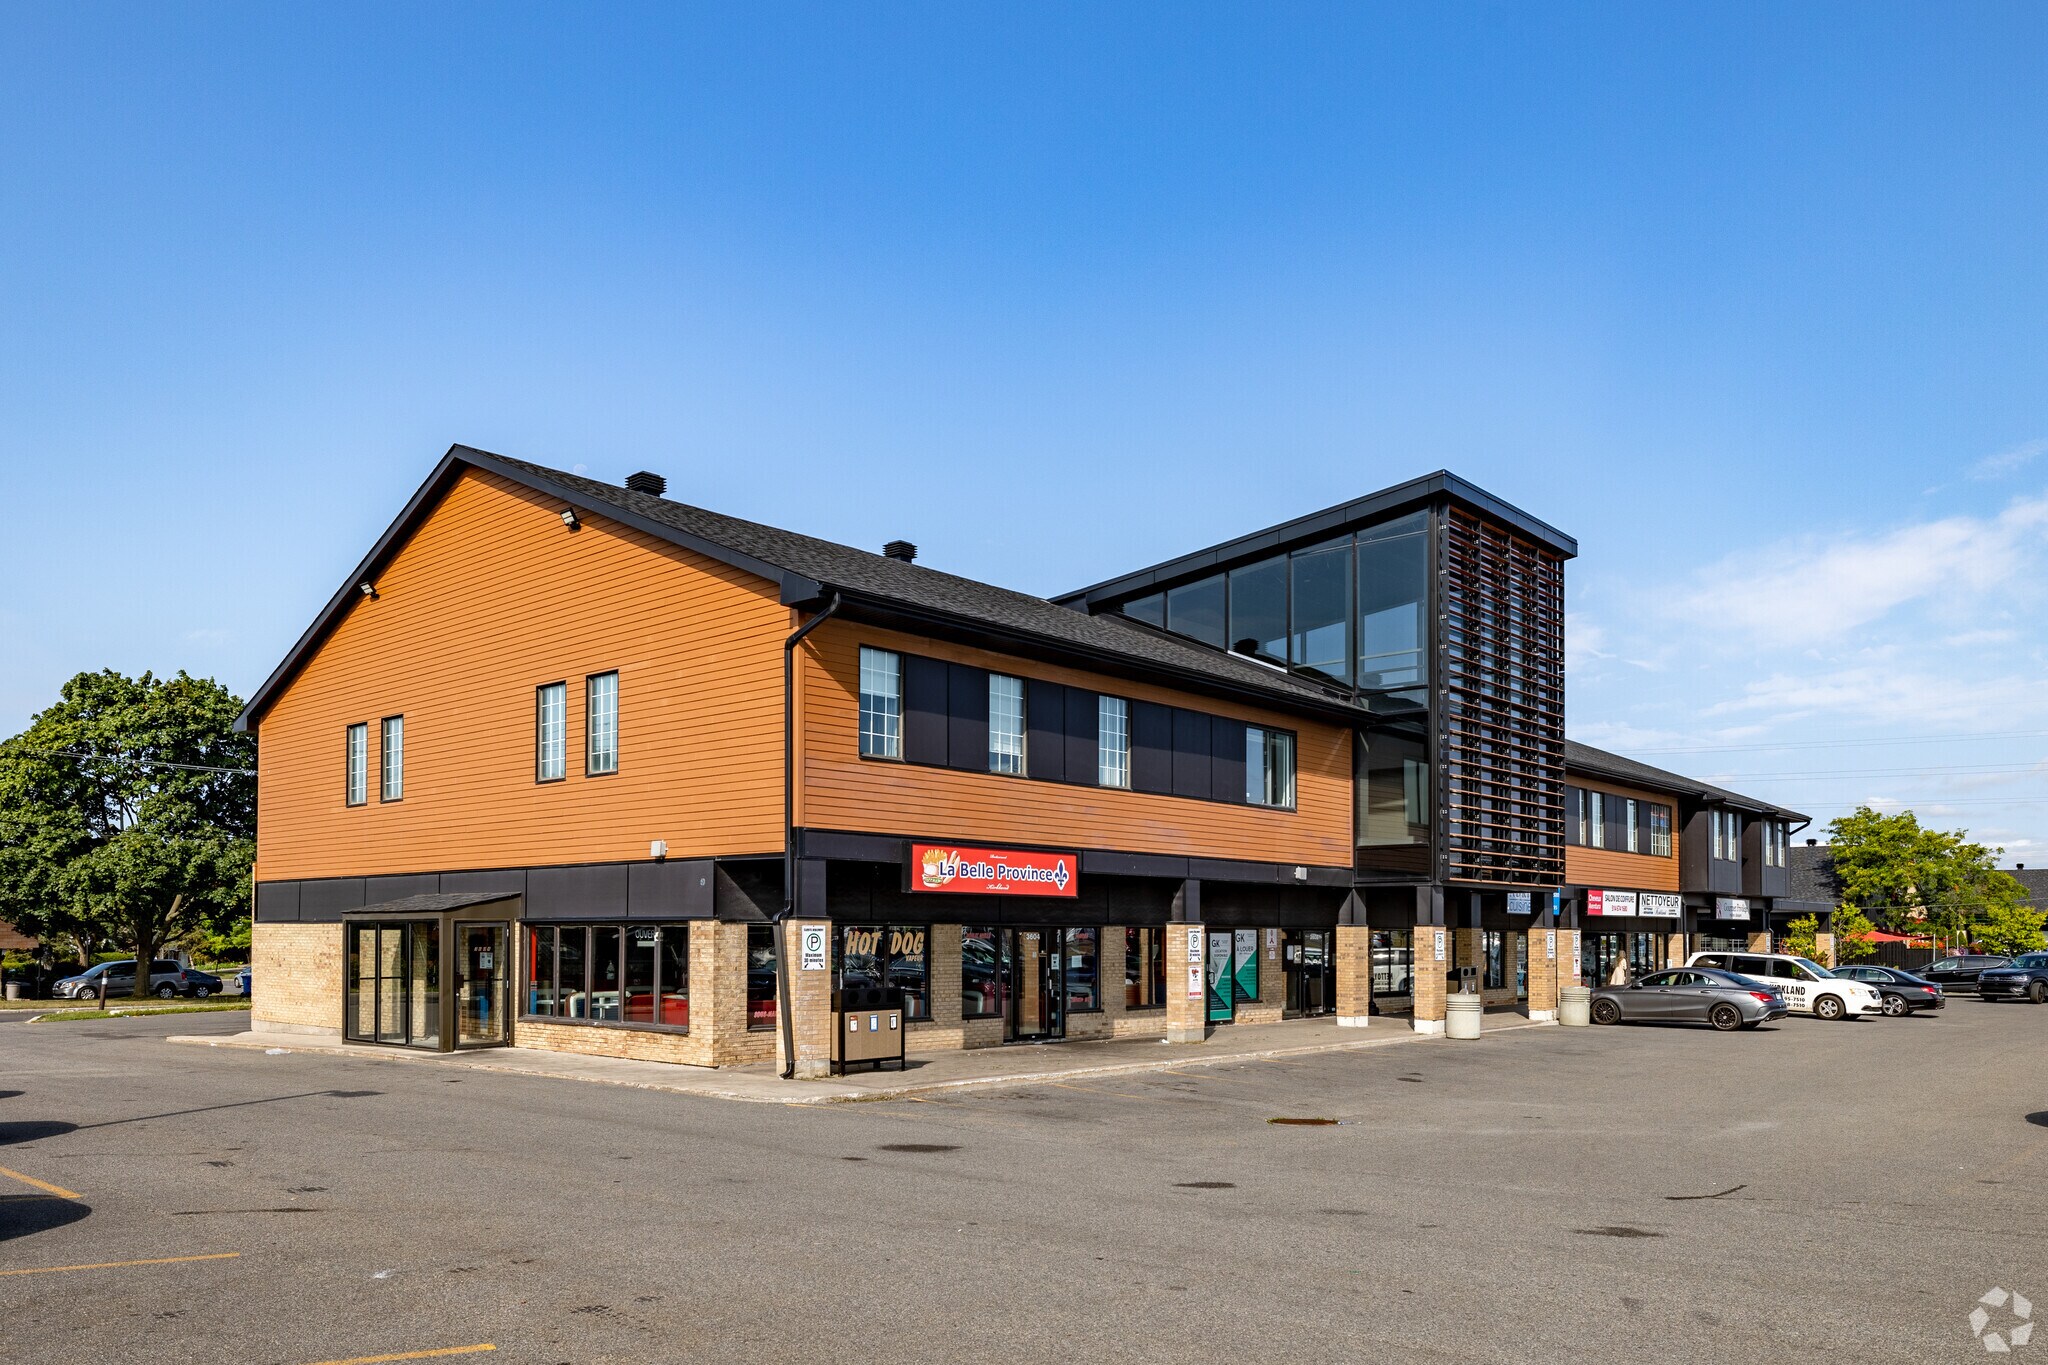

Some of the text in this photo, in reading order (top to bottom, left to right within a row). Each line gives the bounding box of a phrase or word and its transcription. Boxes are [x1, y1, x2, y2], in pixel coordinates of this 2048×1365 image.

[938, 861, 1053, 882] La Belle Province
[1604, 894, 1615, 902] SALON
[1641, 894, 1679, 907] NETTOYEUR
[845, 930, 925, 955] HOT DOG
[1211, 939, 1221, 948] GK
[1235, 933, 1245, 943] GK
